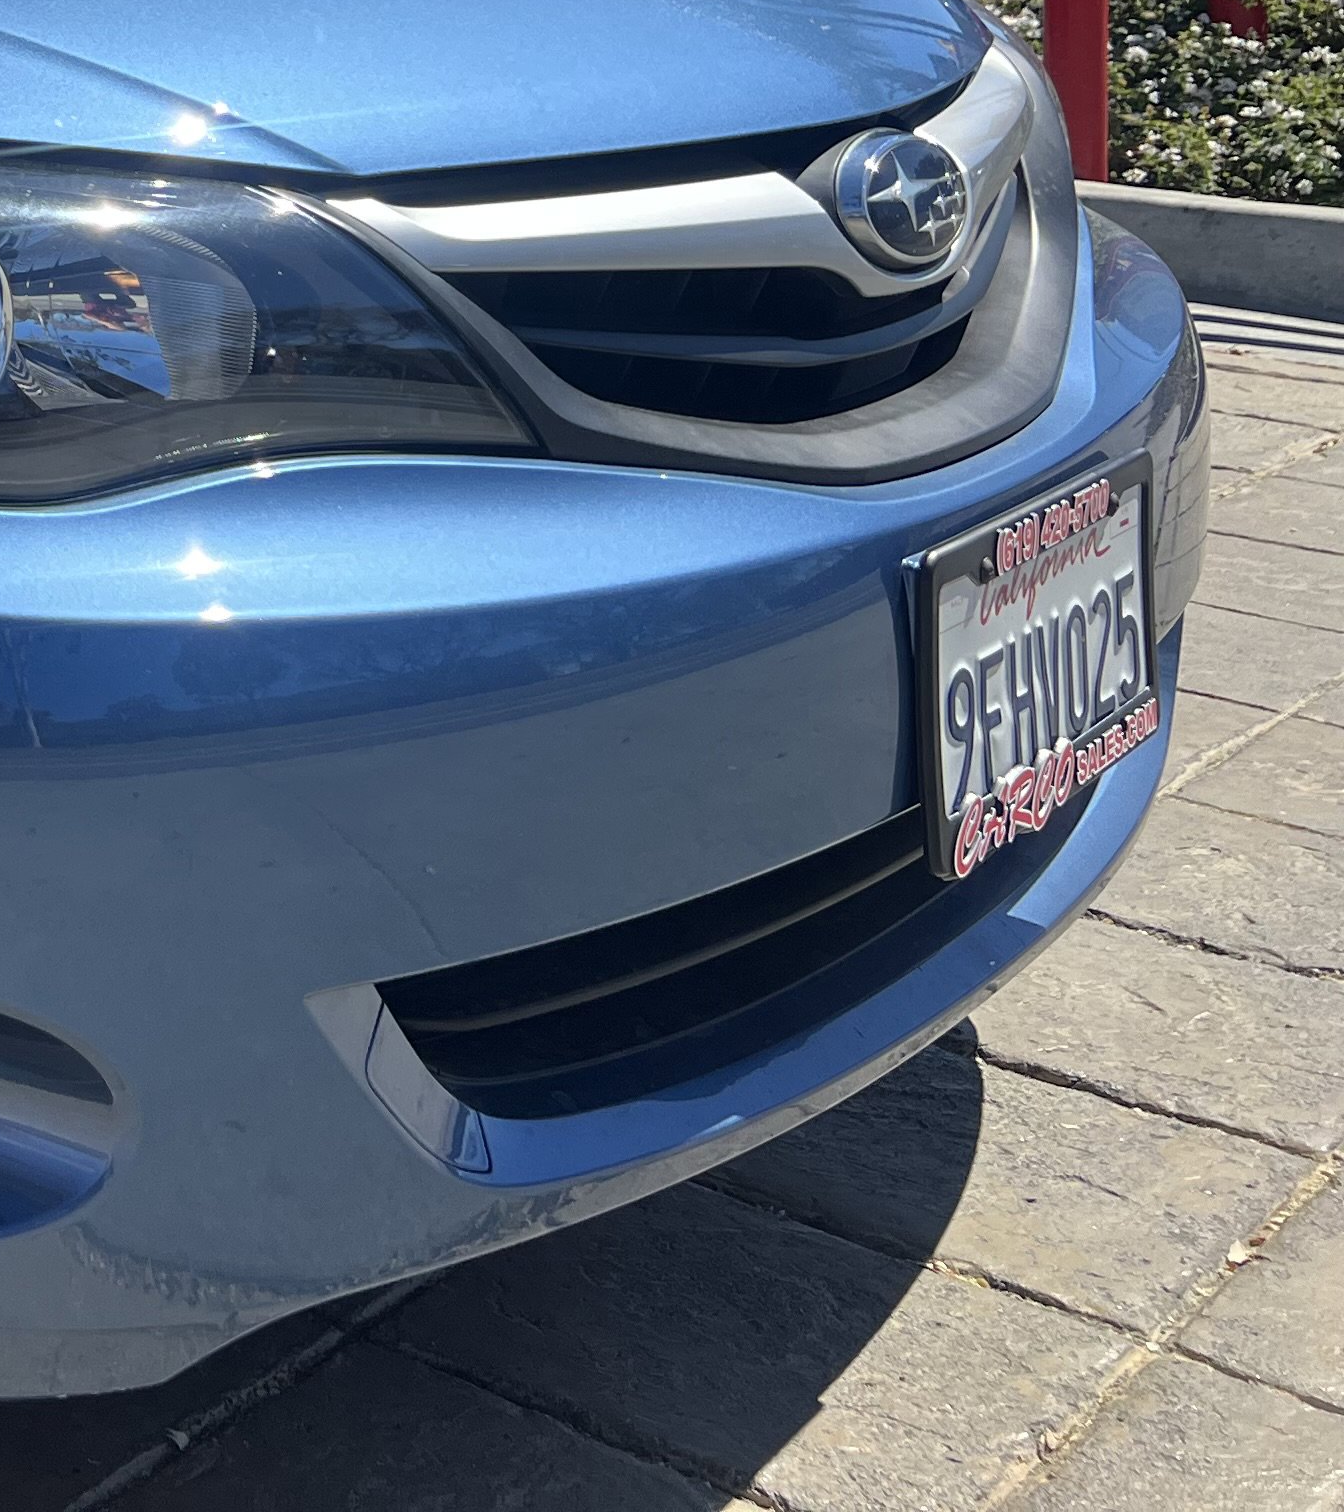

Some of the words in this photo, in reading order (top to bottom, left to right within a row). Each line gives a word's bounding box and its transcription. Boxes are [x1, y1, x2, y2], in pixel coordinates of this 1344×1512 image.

[996, 512, 1040, 577] (619)
[1041, 478, 1110, 549] 420-5700
[947, 571, 1140, 817] 9FHV025
[954, 737, 1075, 879] CARCO
[1076, 698, 1159, 785] SALES.COM
